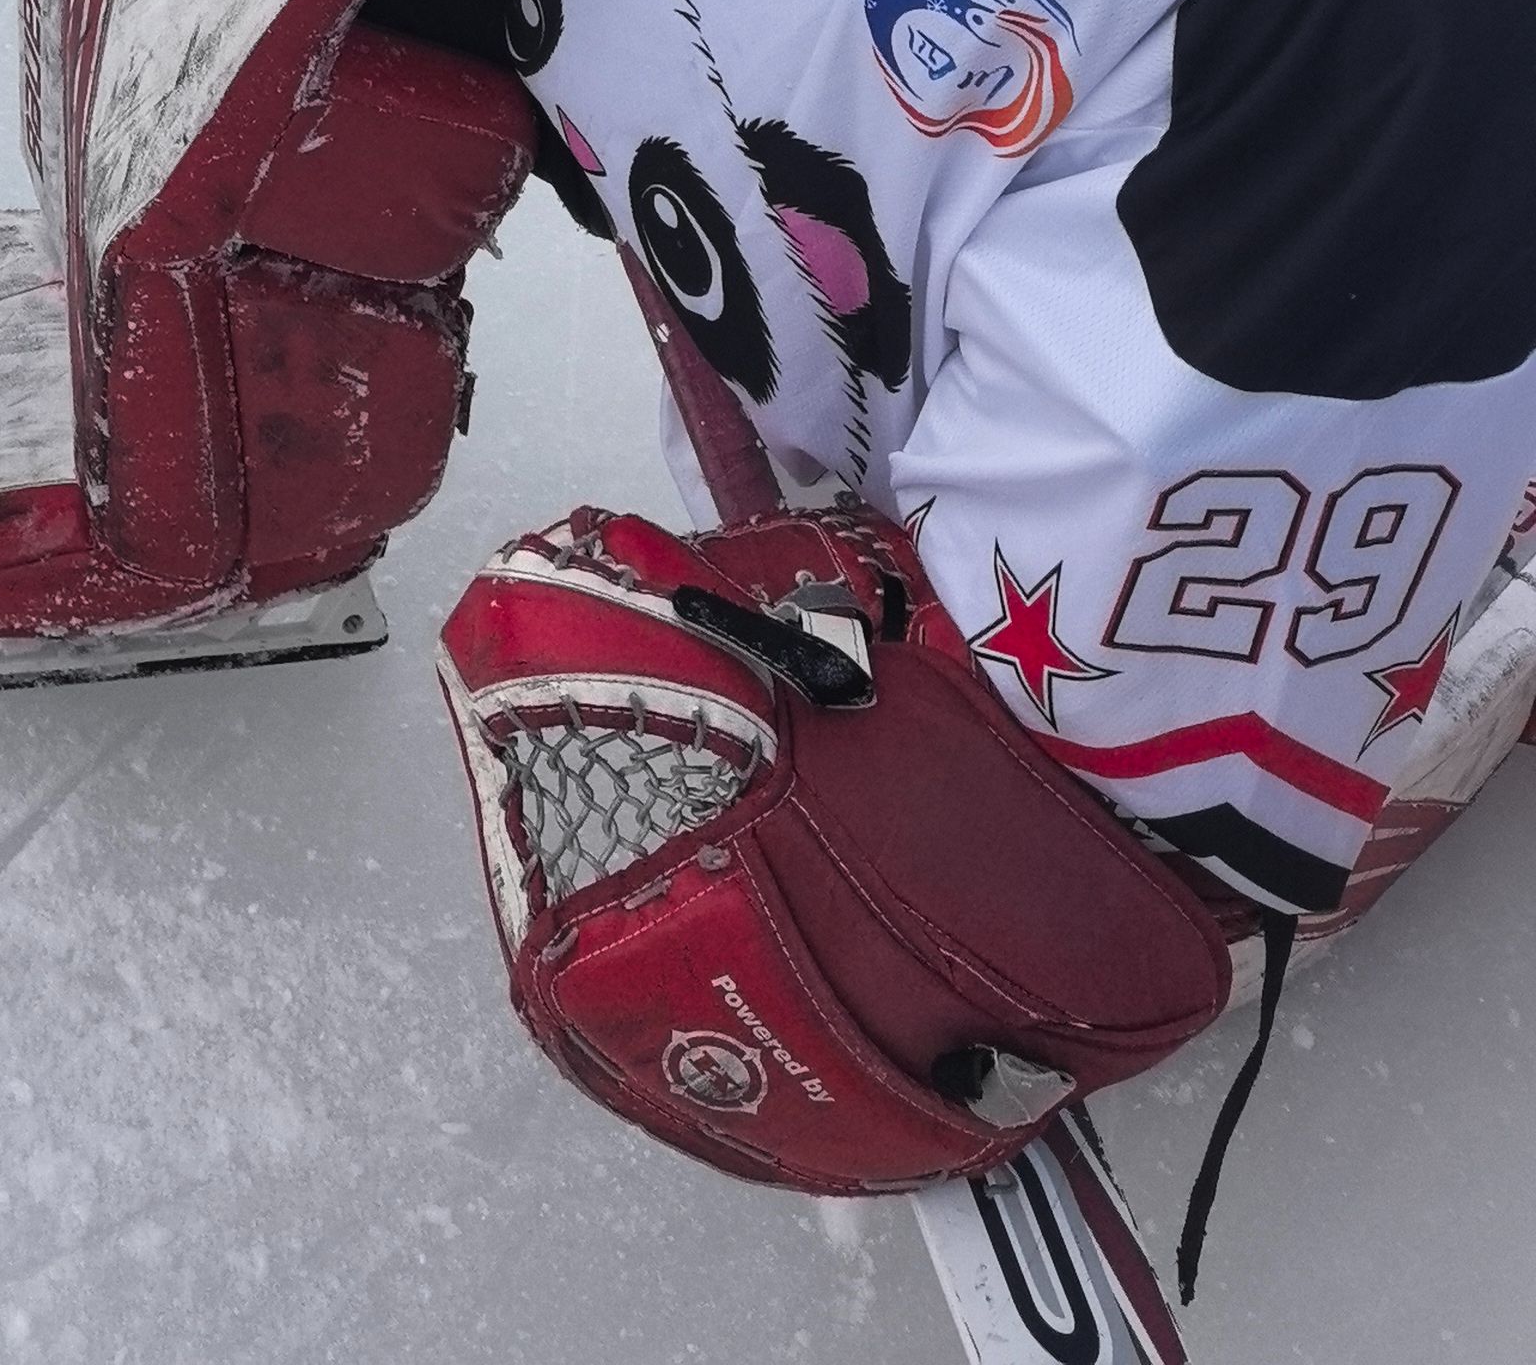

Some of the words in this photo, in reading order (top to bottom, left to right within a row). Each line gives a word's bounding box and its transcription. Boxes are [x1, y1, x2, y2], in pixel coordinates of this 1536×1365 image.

[1100, 464, 1462, 668] 29
[711, 974, 810, 1077] Powered
[800, 1076, 837, 1103] by
